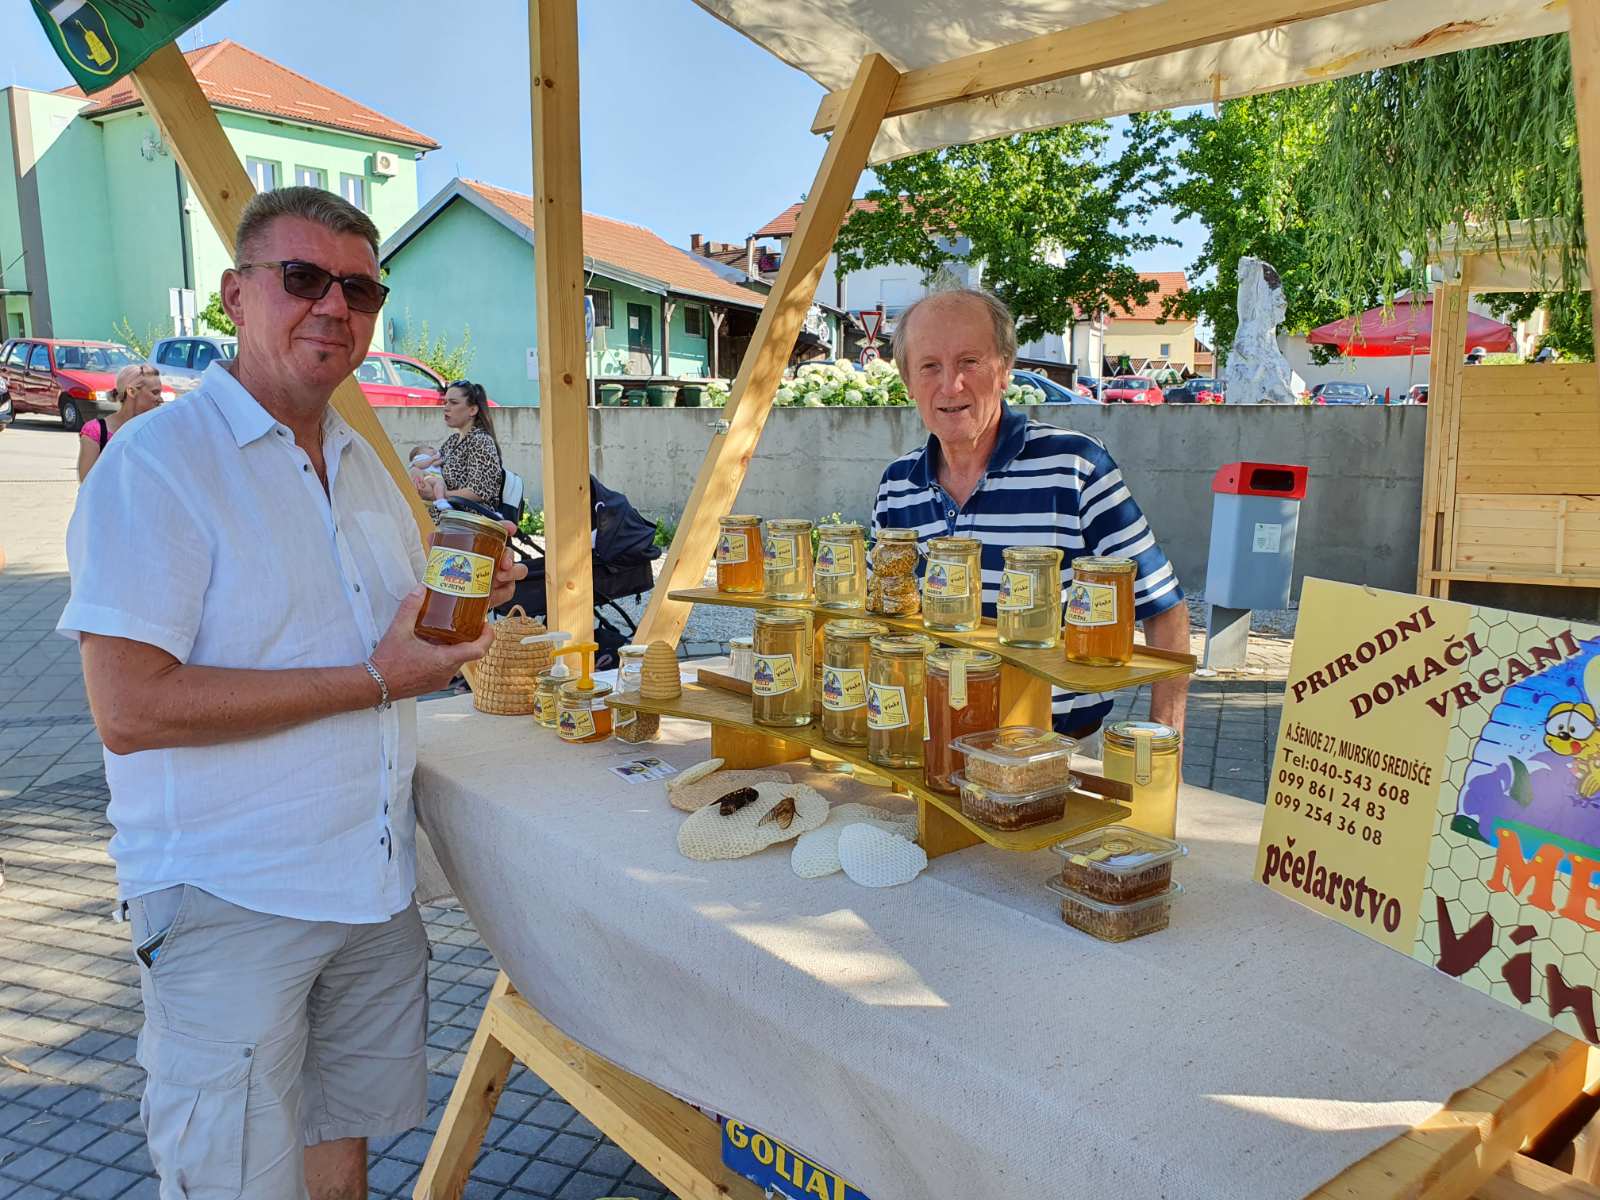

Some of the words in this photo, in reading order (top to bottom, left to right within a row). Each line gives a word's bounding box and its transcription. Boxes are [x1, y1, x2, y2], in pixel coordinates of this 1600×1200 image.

[1291, 605, 1436, 703] PRIRODNI
[1349, 633, 1483, 719] DOMAČI
[1425, 629, 1581, 718] VRCANI
[1283, 748, 1372, 792] Tel:040-543
[1378, 782, 1410, 805] 608
[1285, 721, 1323, 750] A.ŠENOE
[1324, 735, 1336, 757] 27,
[1338, 740, 1380, 768] MURSKO
[1382, 754, 1432, 786] SREDIŠĆE
[1275, 791, 1301, 812] 099
[1305, 803, 1333, 826] 254
[1337, 815, 1356, 835] 36
[1362, 826, 1382, 845] 08
[1279, 769, 1305, 790] 099
[1308, 780, 1334, 802] 861
[1342, 792, 1360, 812] 24
[1366, 802, 1386, 821] 83
[1262, 835, 1402, 933] pčelarstvo
